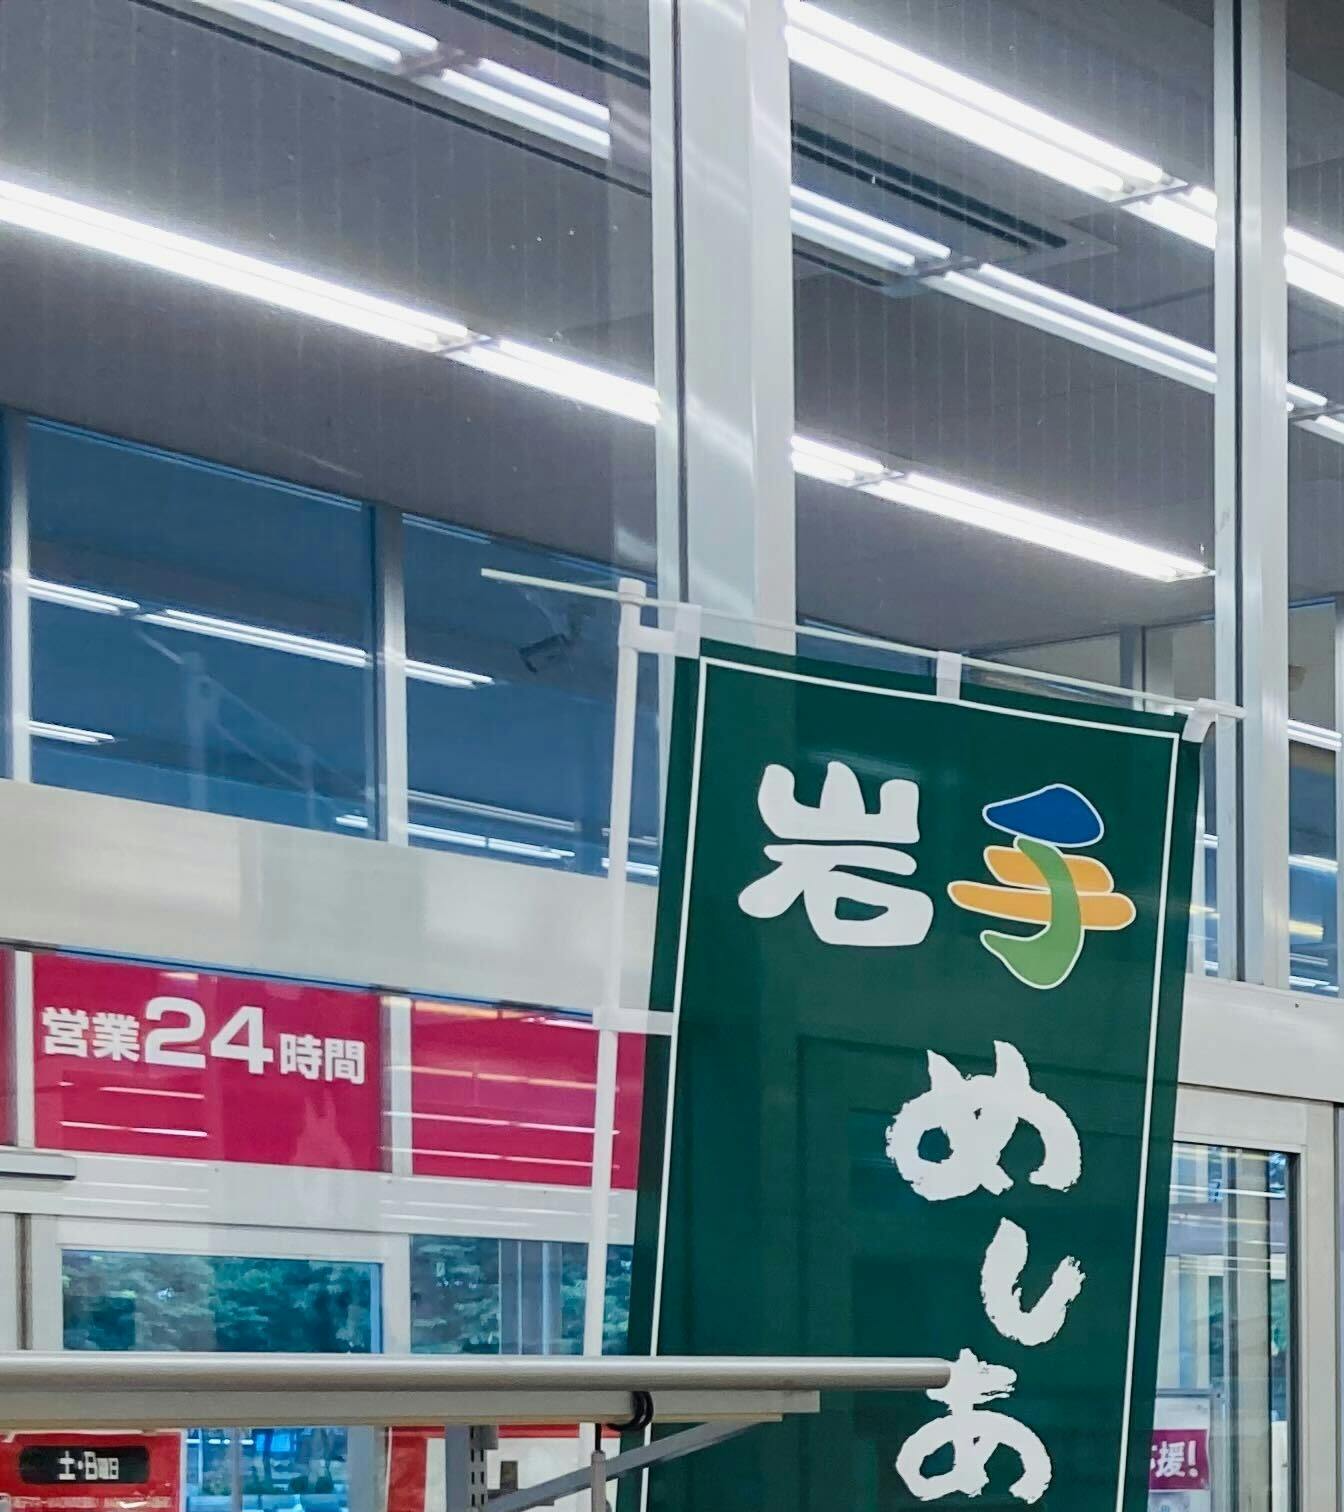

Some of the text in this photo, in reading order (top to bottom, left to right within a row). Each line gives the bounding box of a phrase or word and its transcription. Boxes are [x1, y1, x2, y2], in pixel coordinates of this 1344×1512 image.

[41, 996, 366, 1085] 営業24時間
[1151, 1440, 1199, 1478] 援!
